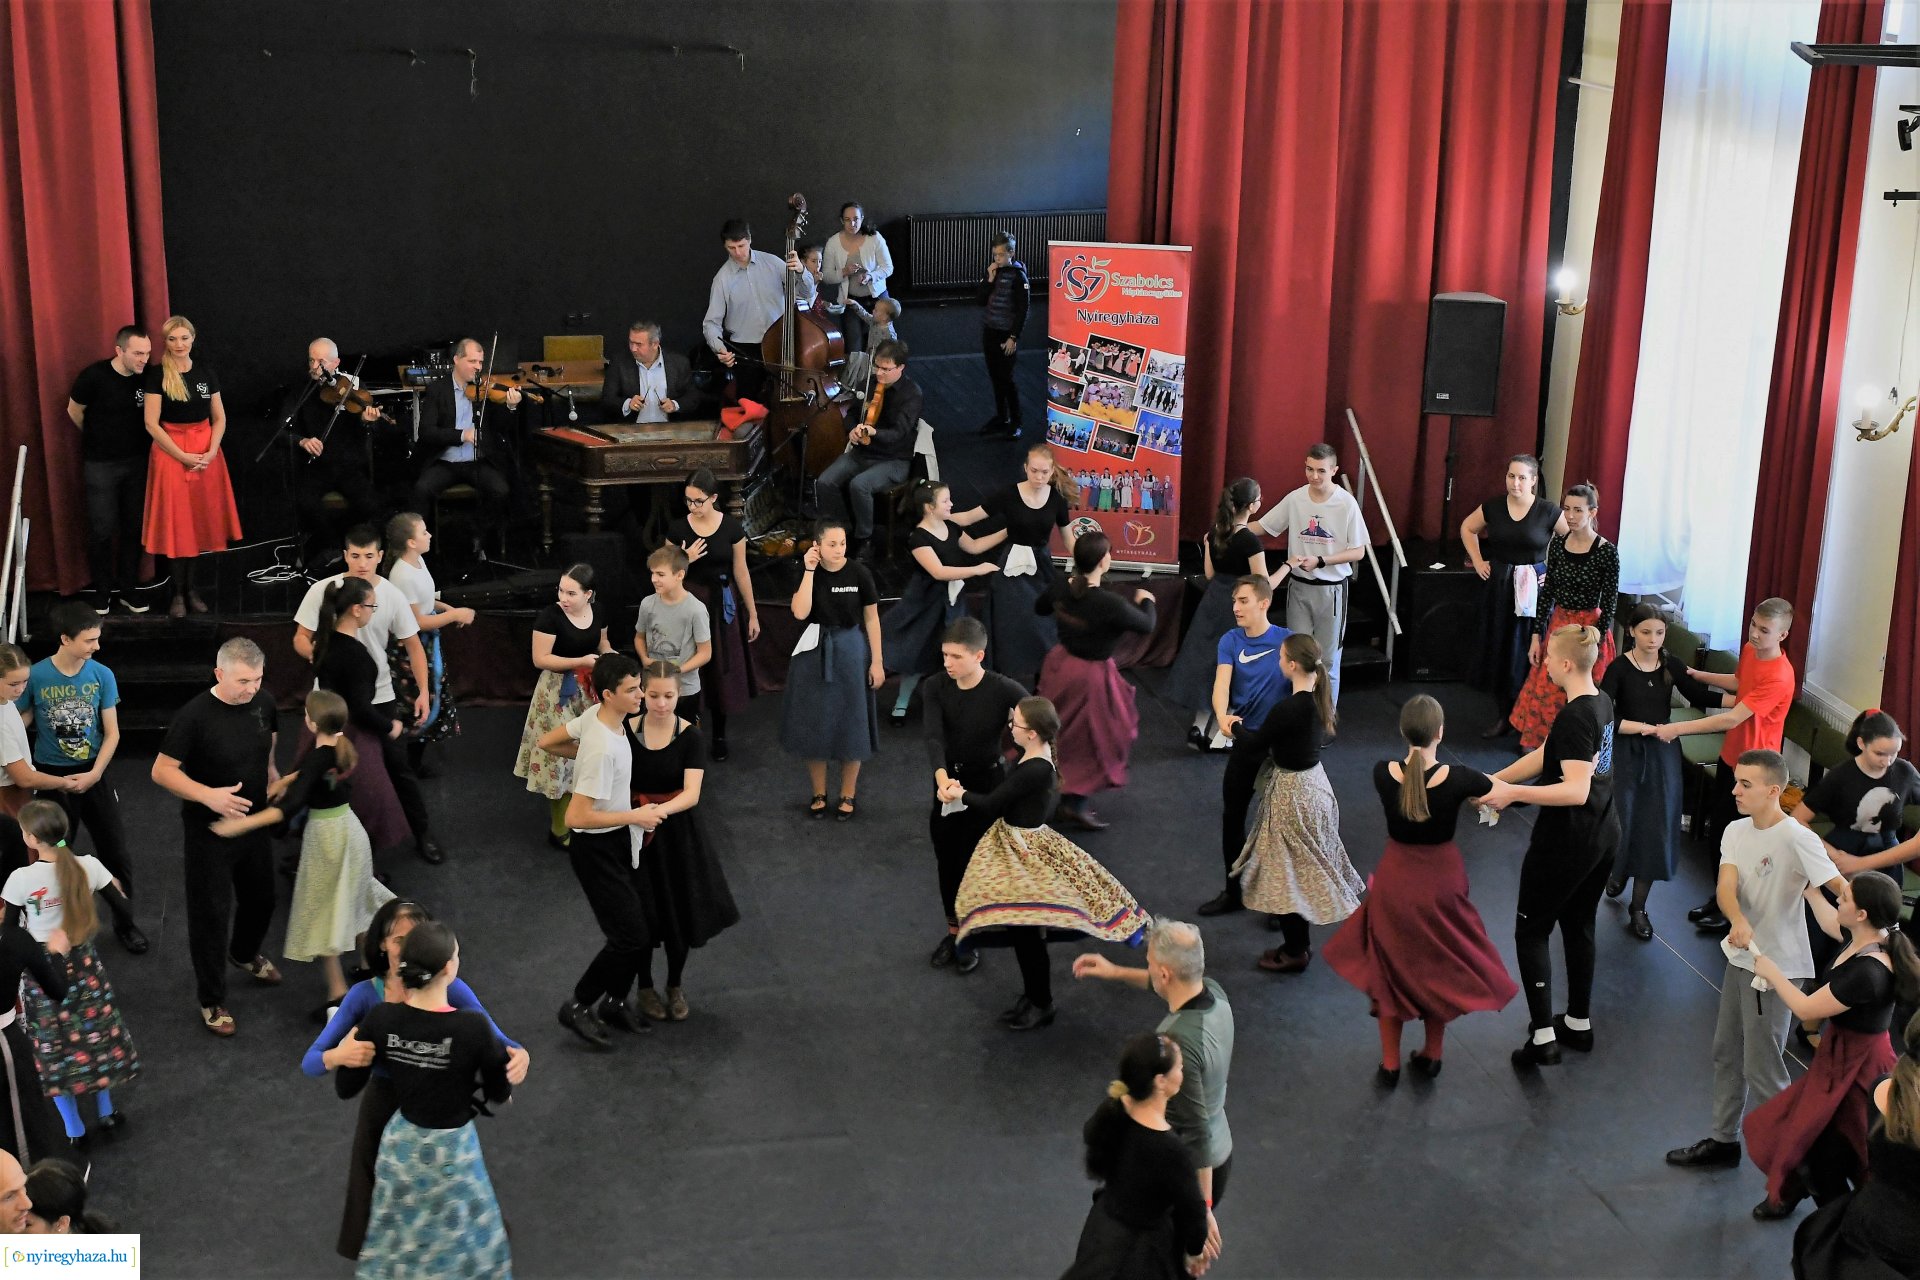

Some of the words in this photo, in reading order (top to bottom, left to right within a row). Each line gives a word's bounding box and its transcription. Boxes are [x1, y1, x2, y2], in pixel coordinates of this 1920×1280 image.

[1111, 272, 1175, 289] Szabolcs
[1076, 308, 1160, 327] Nyíregyháza
[41, 685, 77, 700] KING
[81, 682, 100, 696] OF
